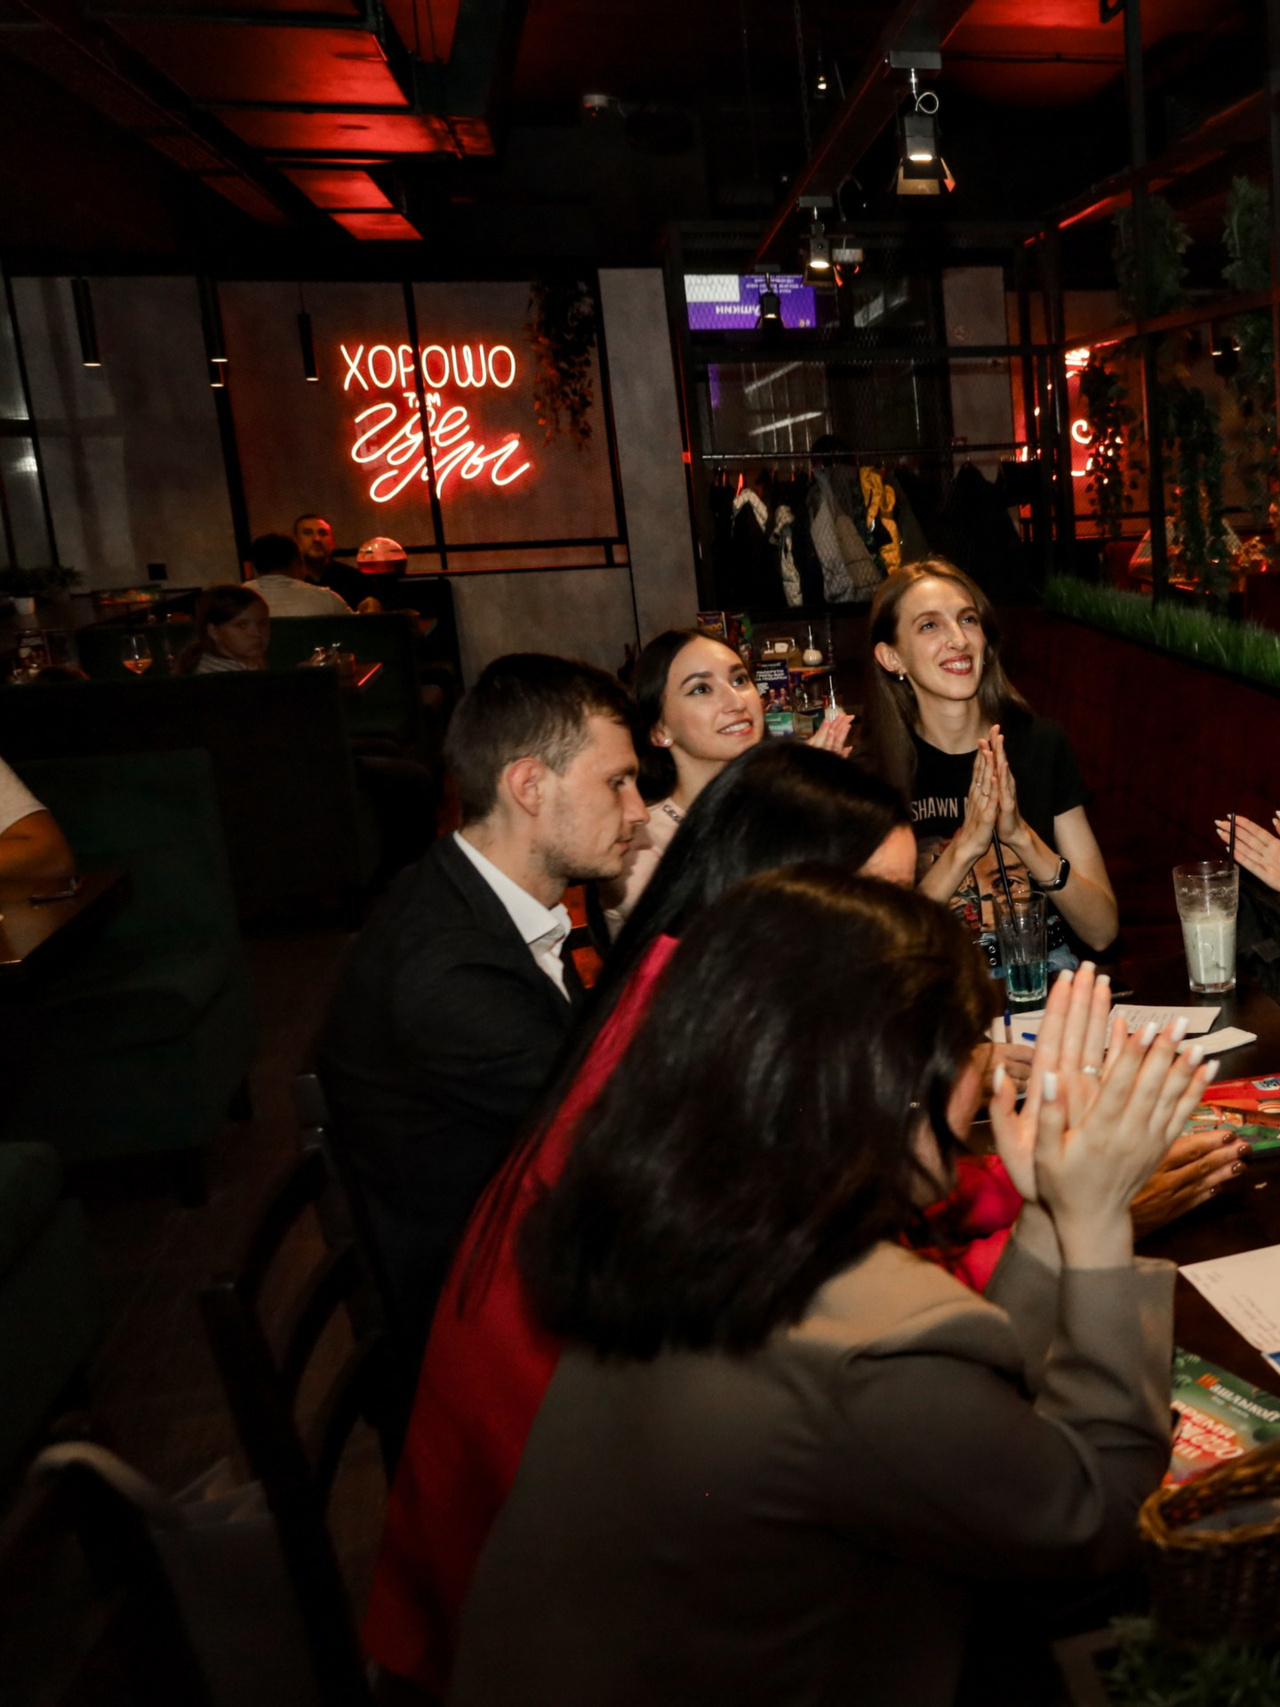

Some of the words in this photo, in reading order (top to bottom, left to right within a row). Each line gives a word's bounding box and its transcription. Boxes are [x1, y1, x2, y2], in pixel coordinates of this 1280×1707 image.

[341, 344, 516, 391] ХОРОШО
[403, 391, 441, 408] ТМ
[910, 797, 959, 822] SHAWN
